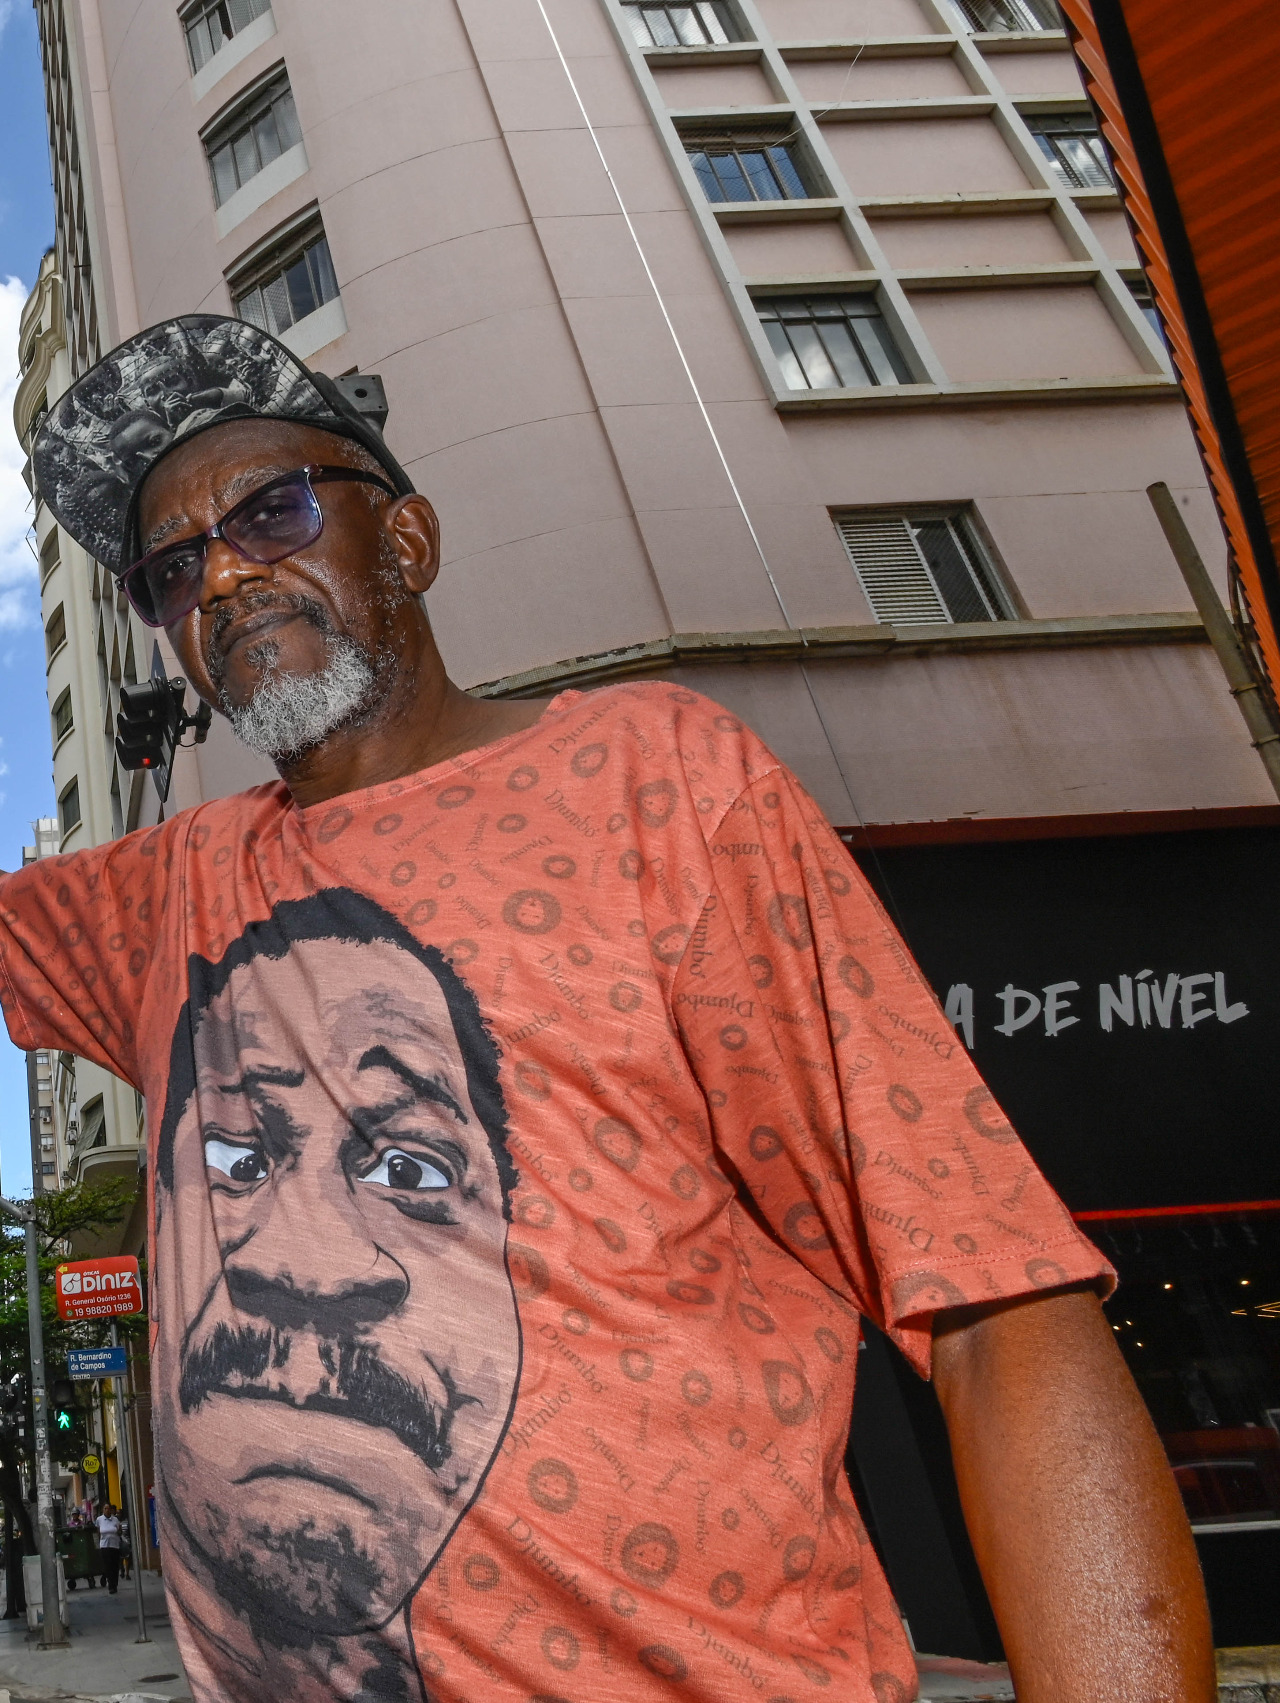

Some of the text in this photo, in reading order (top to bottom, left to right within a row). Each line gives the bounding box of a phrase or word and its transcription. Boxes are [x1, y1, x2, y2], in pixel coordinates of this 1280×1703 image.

[549, 701, 618, 755] Djumbo
[544, 788, 601, 838] Djumbo
[500, 835, 554, 865] Djumbo
[689, 894, 718, 980] Djumbo
[492, 956, 514, 1013] Djumbo
[539, 951, 593, 1020] Djumbo
[677, 991, 756, 1019] Djumbo
[994, 980, 1081, 1037] DE
[1099, 968, 1251, 1032] NÍVEL
[878, 1004, 956, 1061] Djumbo
[873, 1150, 943, 1201] Djumbo
[72, 1297, 96, 1306] General
[96, 1294, 117, 1303] Osório
[74, 1302, 134, 1317] 19 98820 1989
[82, 1271, 135, 1293] DINIZ
[70, 1351, 112, 1362] R. Bernardino
[70, 1361, 106, 1371] de Campos
[538, 1323, 609, 1394] Djumbo
[501, 1381, 572, 1457] Djumbo
[582, 1425, 636, 1494] Djumbo
[693, 1479, 711, 1556] Djumbo
[738, 1487, 784, 1550] Djumbo
[506, 1515, 593, 1608] Djumbo
[686, 1615, 769, 1690] Djumbo
